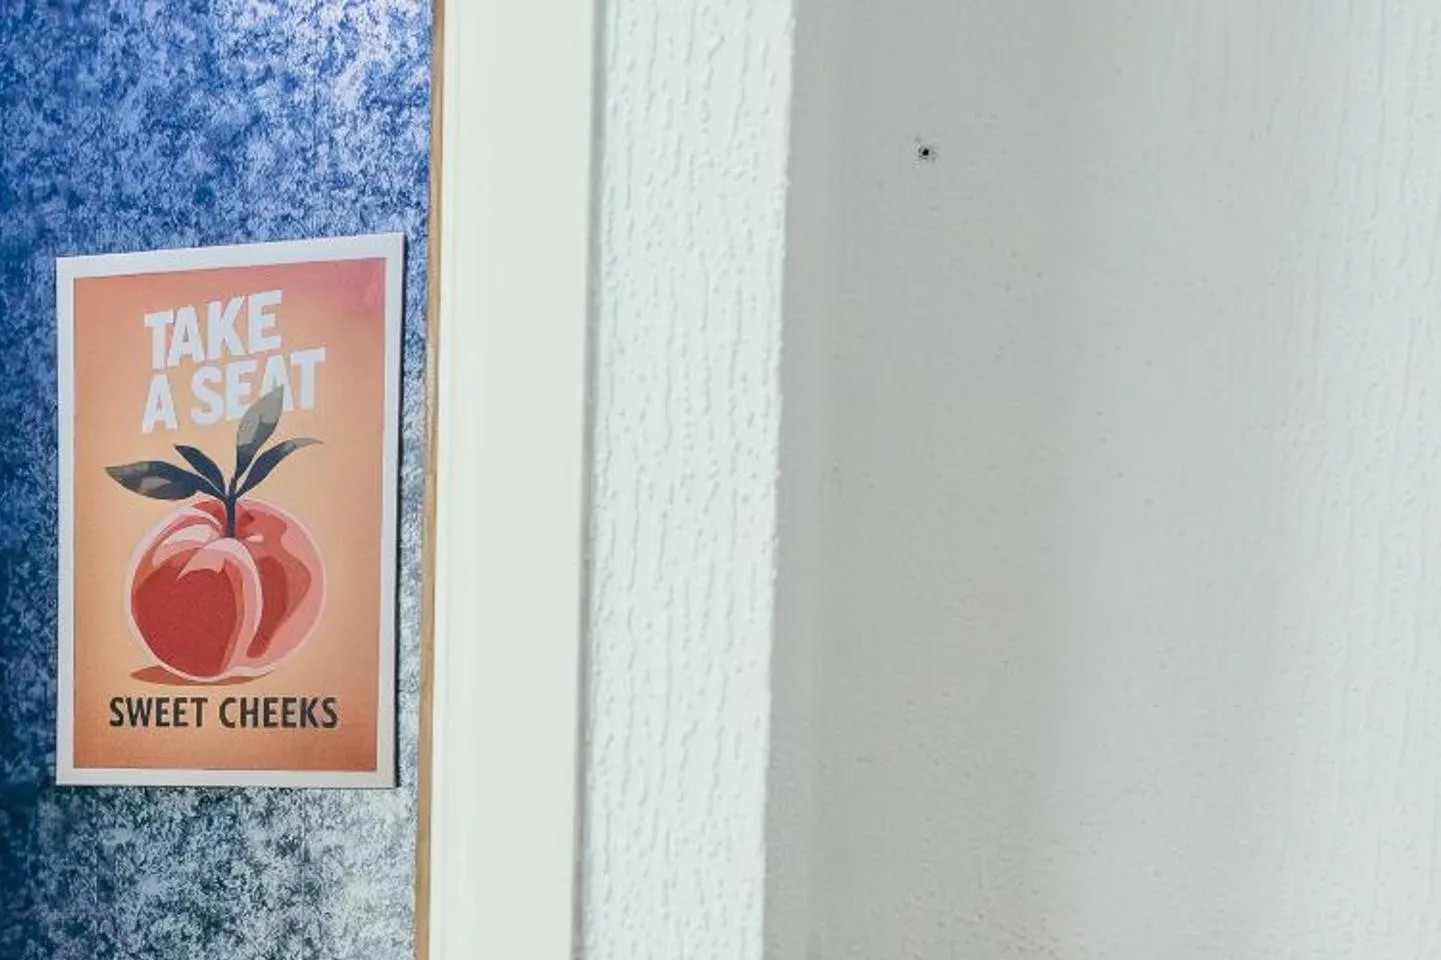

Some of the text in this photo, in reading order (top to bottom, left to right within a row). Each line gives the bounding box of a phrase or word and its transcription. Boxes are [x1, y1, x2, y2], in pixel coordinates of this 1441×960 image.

[144, 290, 282, 369] TAKE
[142, 348, 326, 432] A SEAT
[108, 696, 339, 730] SWEET CHEEKS
